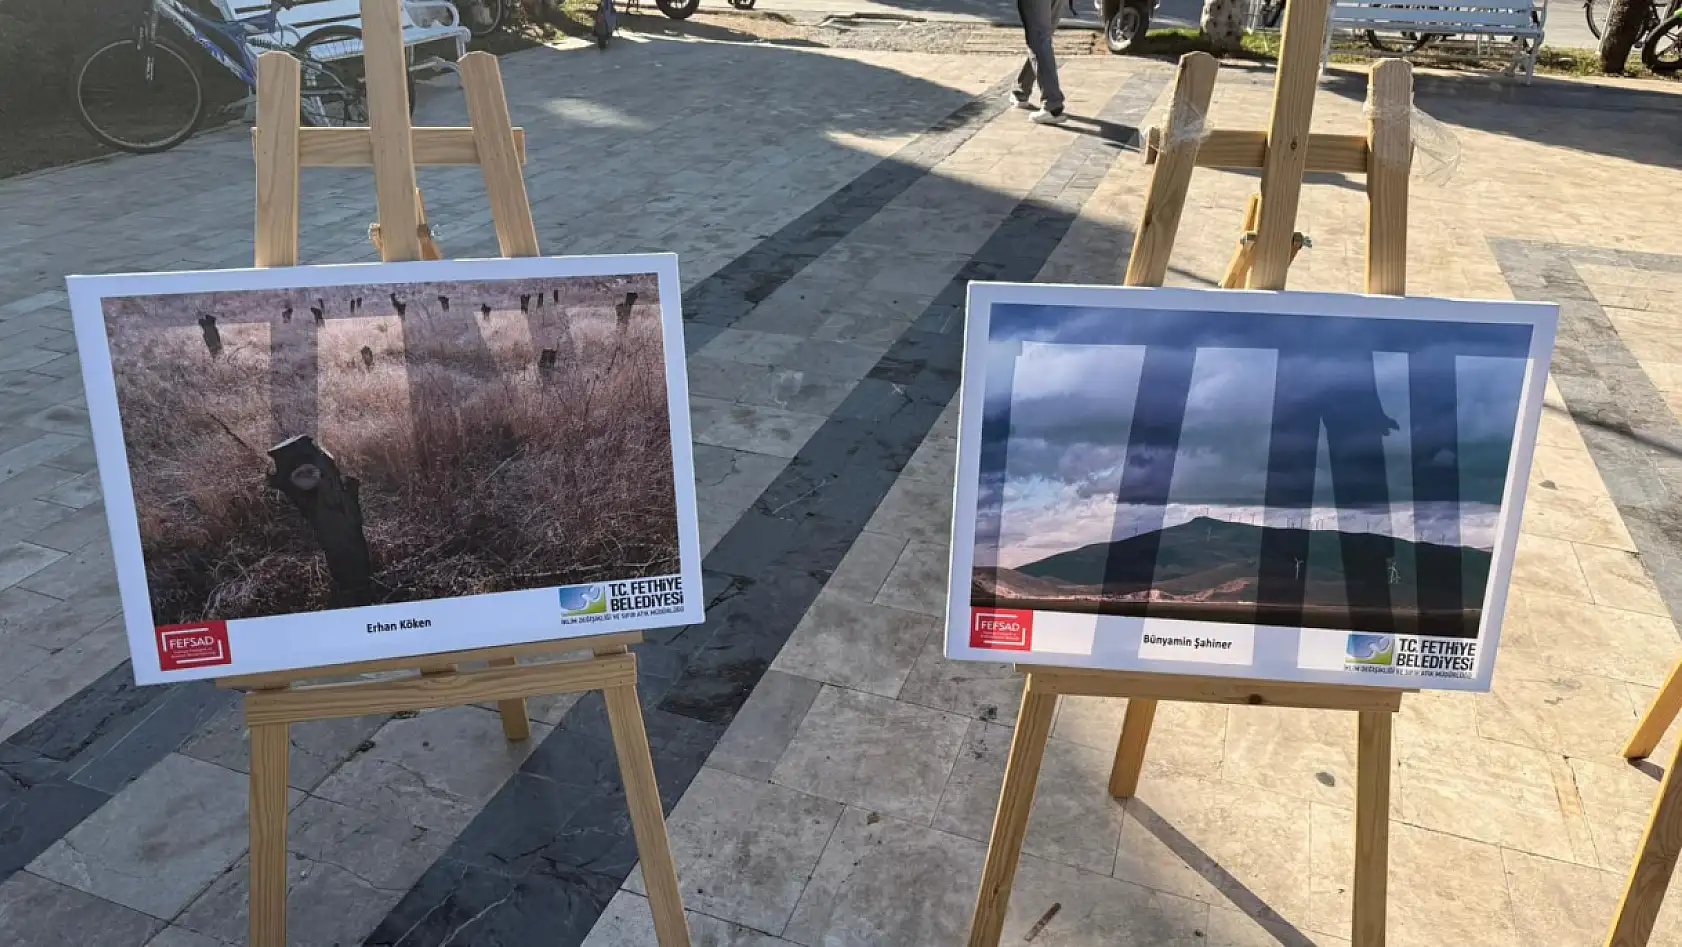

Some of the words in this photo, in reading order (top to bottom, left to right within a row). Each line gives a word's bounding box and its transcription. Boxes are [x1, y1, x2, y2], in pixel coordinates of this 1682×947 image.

[609, 583, 630, 597] T.C.
[366, 621, 398, 633] Erhan
[399, 618, 432, 630] Köken
[981, 620, 1020, 632] FEFSAD
[169, 635, 214, 650] FEFSAD
[1143, 634, 1193, 647] Bünyamin
[1194, 637, 1233, 650] Şahiner
